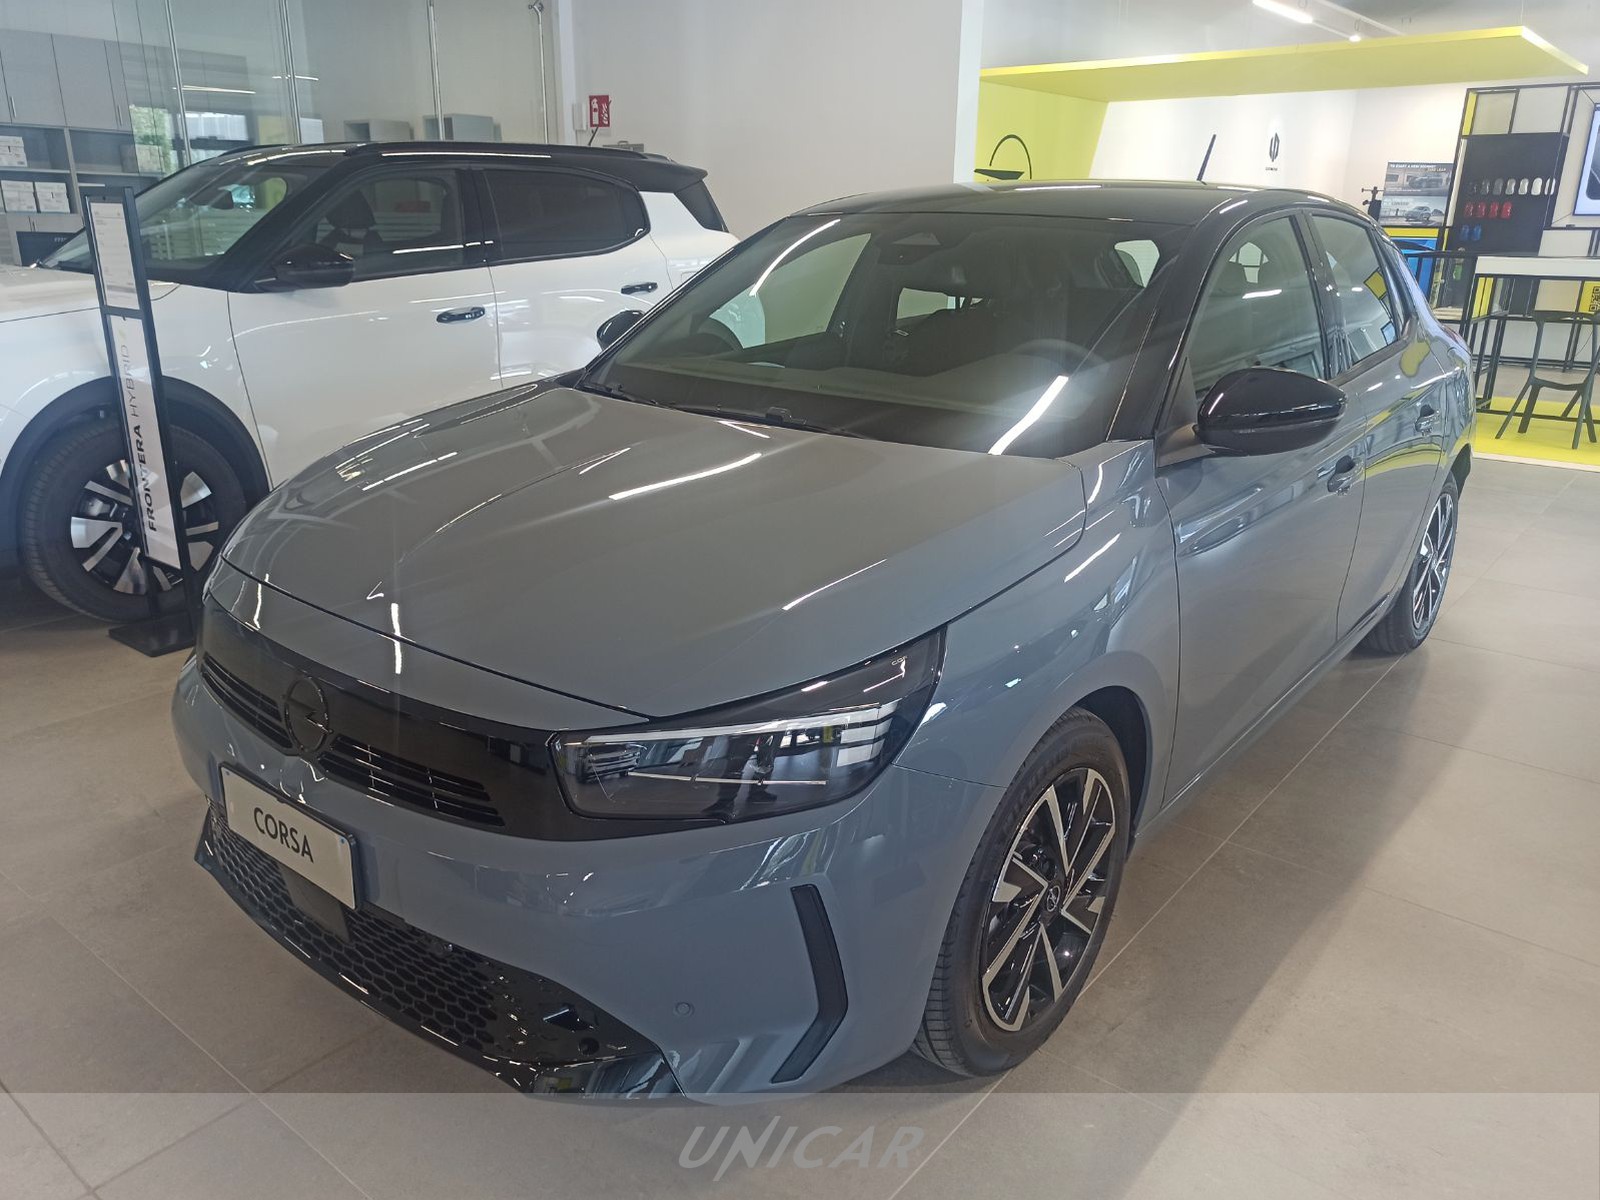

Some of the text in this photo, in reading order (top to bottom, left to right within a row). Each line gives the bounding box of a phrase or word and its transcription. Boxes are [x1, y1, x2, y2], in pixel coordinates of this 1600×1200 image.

[120, 344, 157, 532] FRONTERA HYBRID
[253, 807, 314, 864] CORSA
